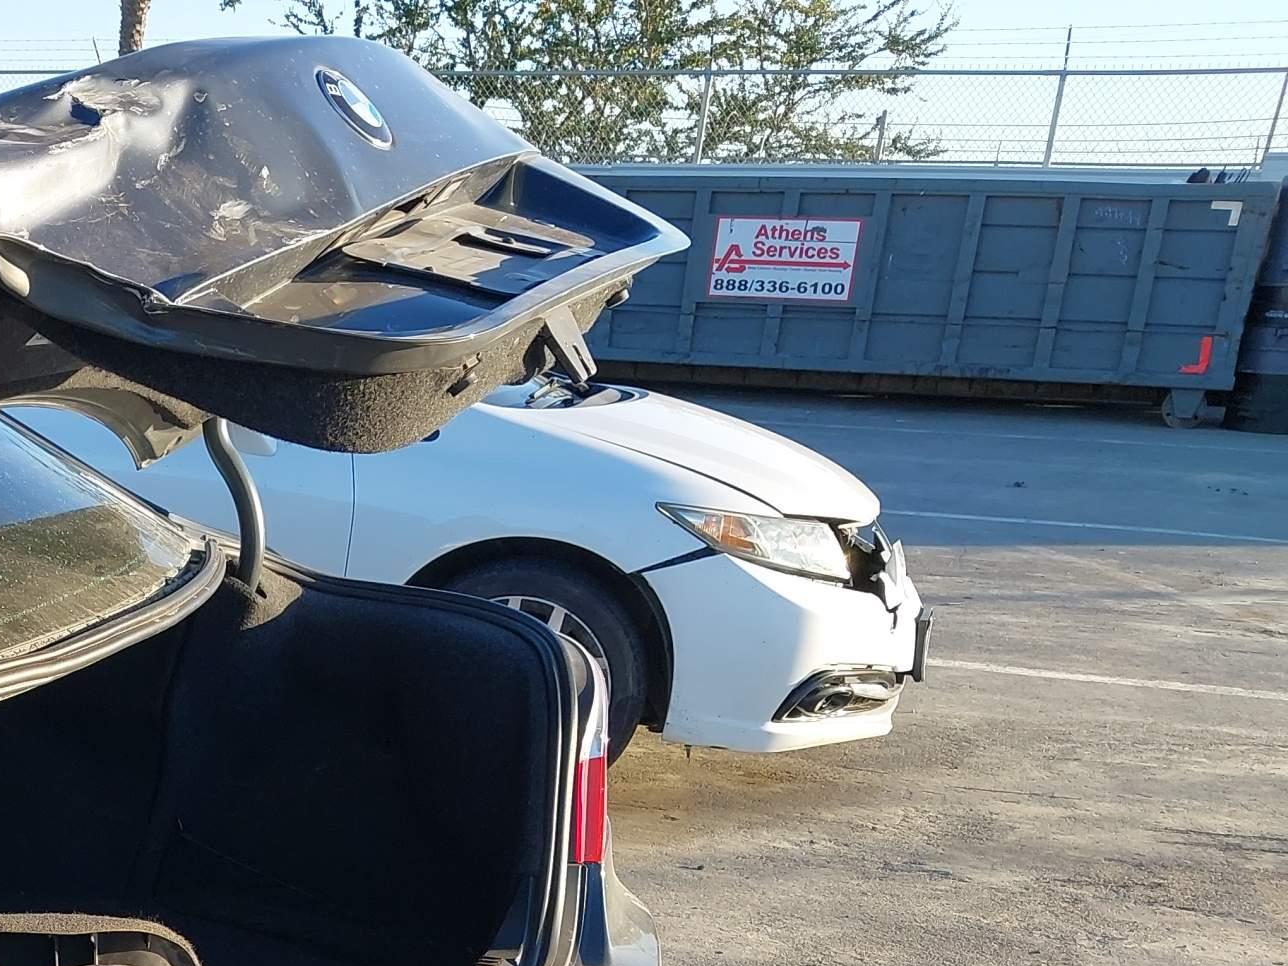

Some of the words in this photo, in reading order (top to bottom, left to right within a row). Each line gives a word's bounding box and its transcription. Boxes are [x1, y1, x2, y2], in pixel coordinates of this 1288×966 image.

[754, 223, 828, 242] Athens
[752, 241, 841, 260] Services
[713, 278, 846, 296] 888/336-6100
